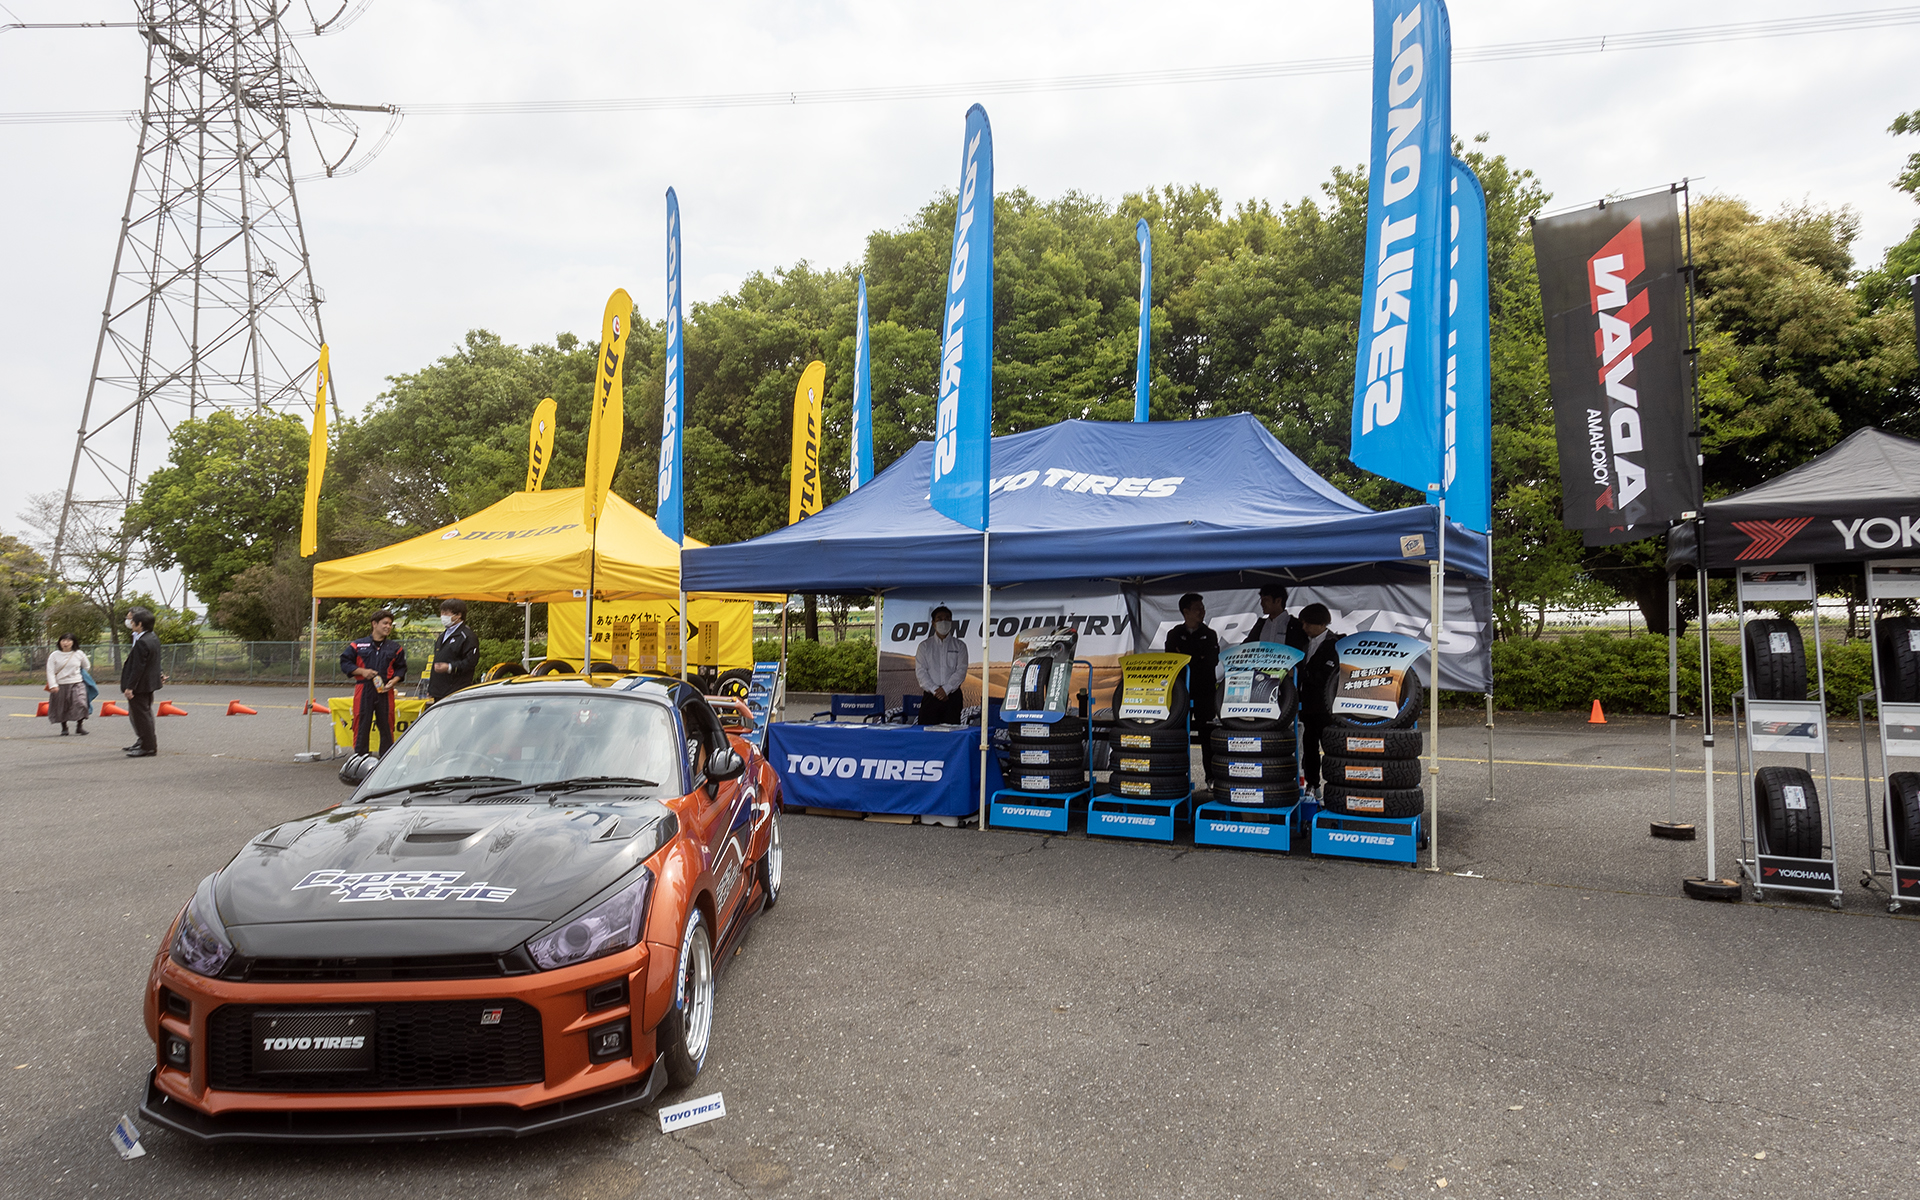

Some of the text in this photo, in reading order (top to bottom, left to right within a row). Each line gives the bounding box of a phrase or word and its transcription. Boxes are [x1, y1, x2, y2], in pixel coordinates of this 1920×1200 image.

[1042, 466, 1186, 499] TIRES
[457, 522, 580, 542] DUNLOP
[890, 614, 1131, 642] OPN COUNTRY
[1357, 639, 1398, 650] OPEN
[1343, 647, 1410, 658] COUNTRY
[1340, 701, 1389, 711] TOYO TIRES
[787, 754, 945, 782] TOYO TIRES
[1002, 806, 1052, 817] TOYO TIRES
[1101, 814, 1156, 826] TOYO TIRES
[1209, 823, 1270, 835] TOYO TIRES
[1328, 832, 1395, 846] TOYO TIRES
[1778, 868, 1831, 881] YOKOHAMA
[262, 1035, 365, 1051] TOYO TIRES
[663, 1101, 721, 1125] TOYO TIRES
